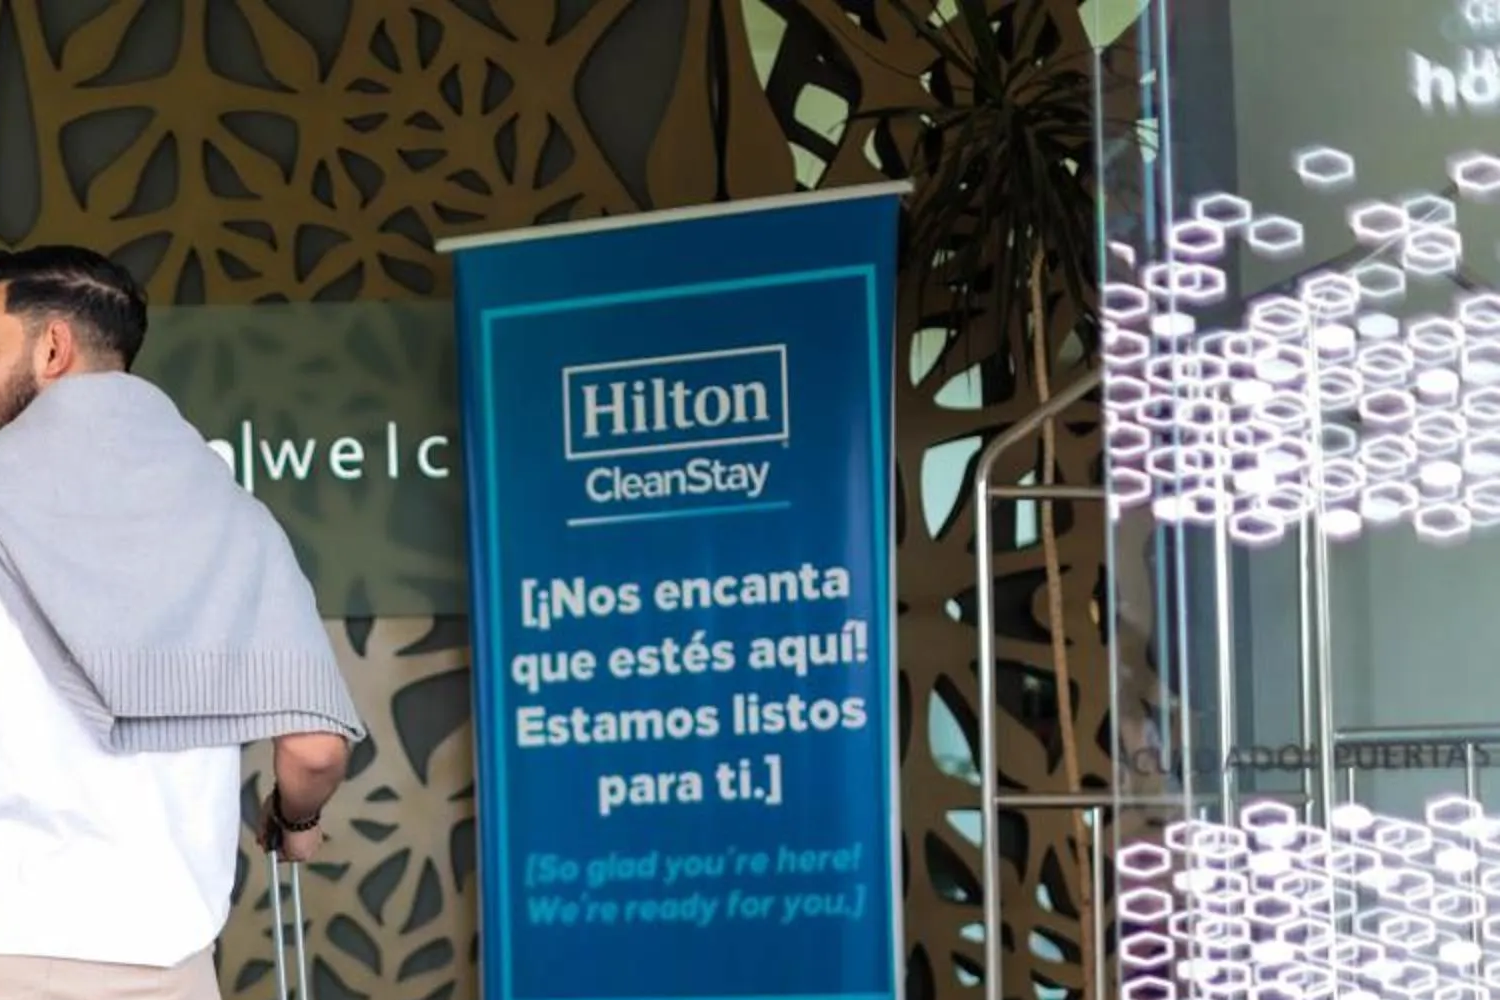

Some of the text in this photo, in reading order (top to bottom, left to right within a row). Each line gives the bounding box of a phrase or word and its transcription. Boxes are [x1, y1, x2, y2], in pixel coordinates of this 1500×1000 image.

[582, 378, 770, 438] Hilton
[585, 457, 770, 503] CleanStay
[521, 563, 850, 630] [¡Nos encanta
[512, 619, 868, 694] que estés aquí!
[516, 693, 868, 747] Estamos listos
[598, 753, 783, 817] para ti.]
[587, 851, 660, 889] glad
[777, 842, 863, 874] here!
[624, 890, 719, 928] ready
[727, 888, 775, 918] for
